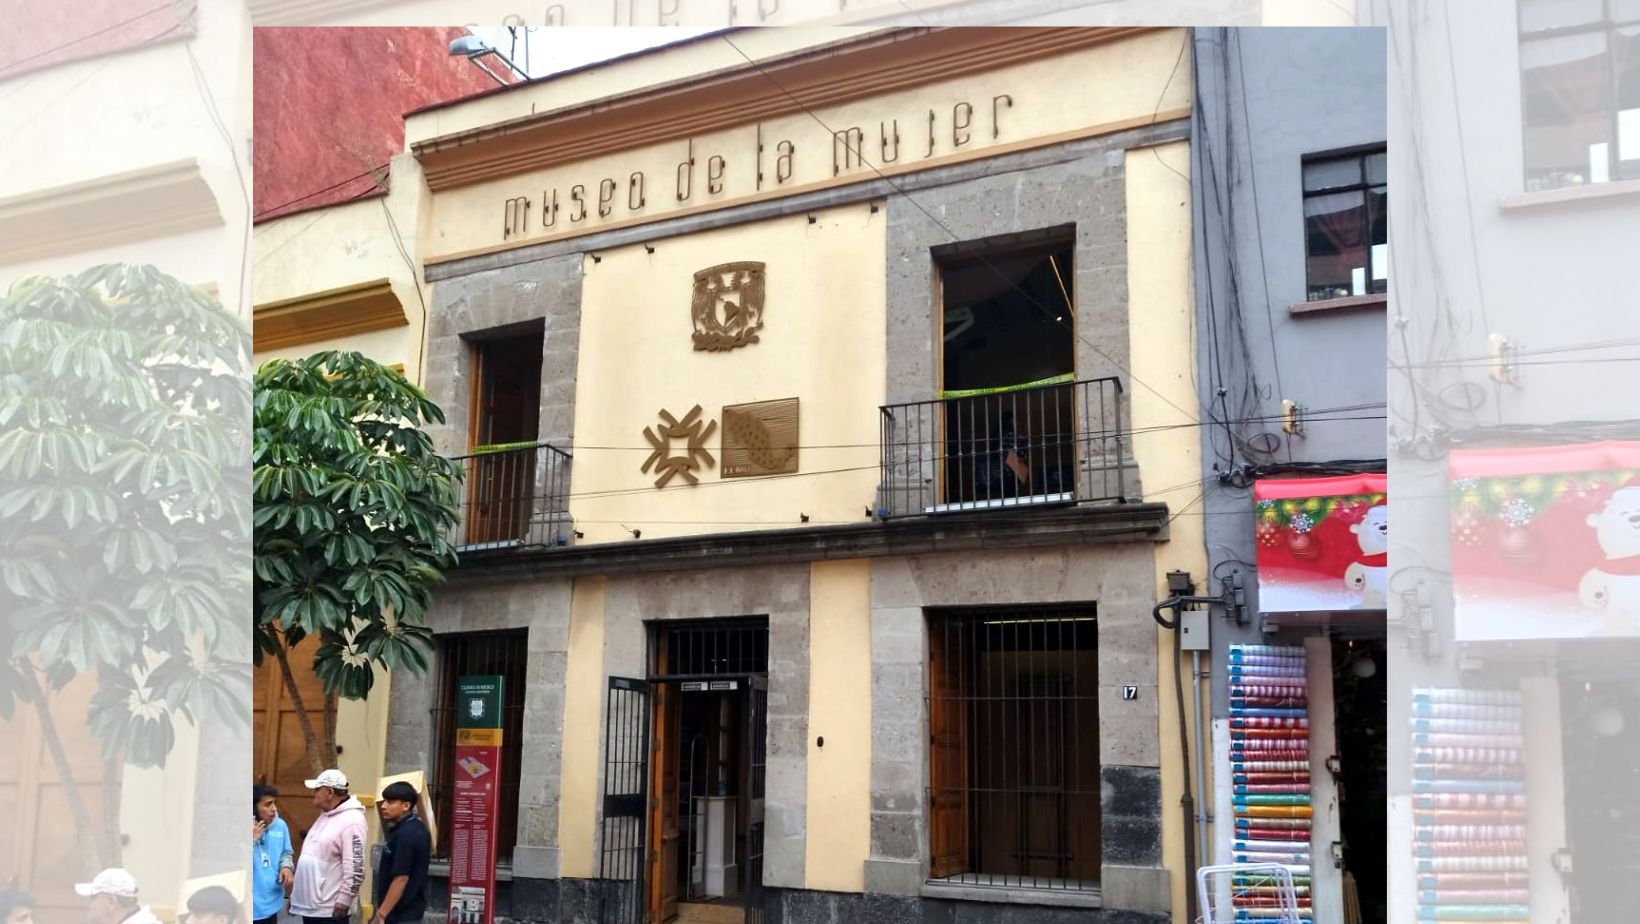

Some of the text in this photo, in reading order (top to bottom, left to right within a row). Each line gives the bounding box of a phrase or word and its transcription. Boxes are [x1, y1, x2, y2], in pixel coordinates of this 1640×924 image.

[504, 94, 1013, 241] museo de la mujer
[1124, 686, 1137, 699] 17
